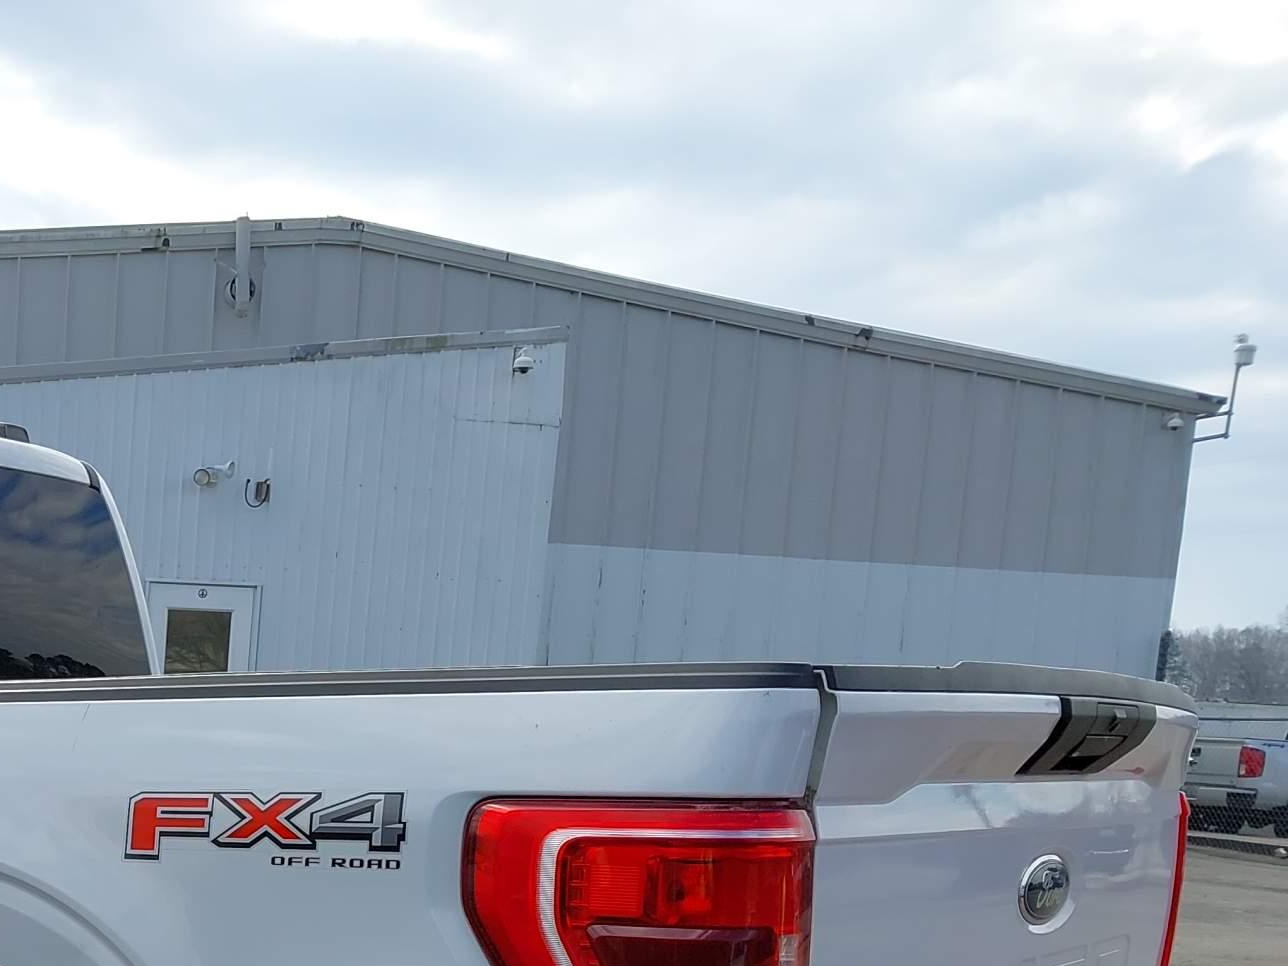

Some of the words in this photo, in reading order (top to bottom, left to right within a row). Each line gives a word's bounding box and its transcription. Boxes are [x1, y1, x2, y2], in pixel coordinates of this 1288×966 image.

[124, 791, 406, 861] FX4
[270, 855, 321, 867] OFF
[330, 857, 401, 870] ROAD
